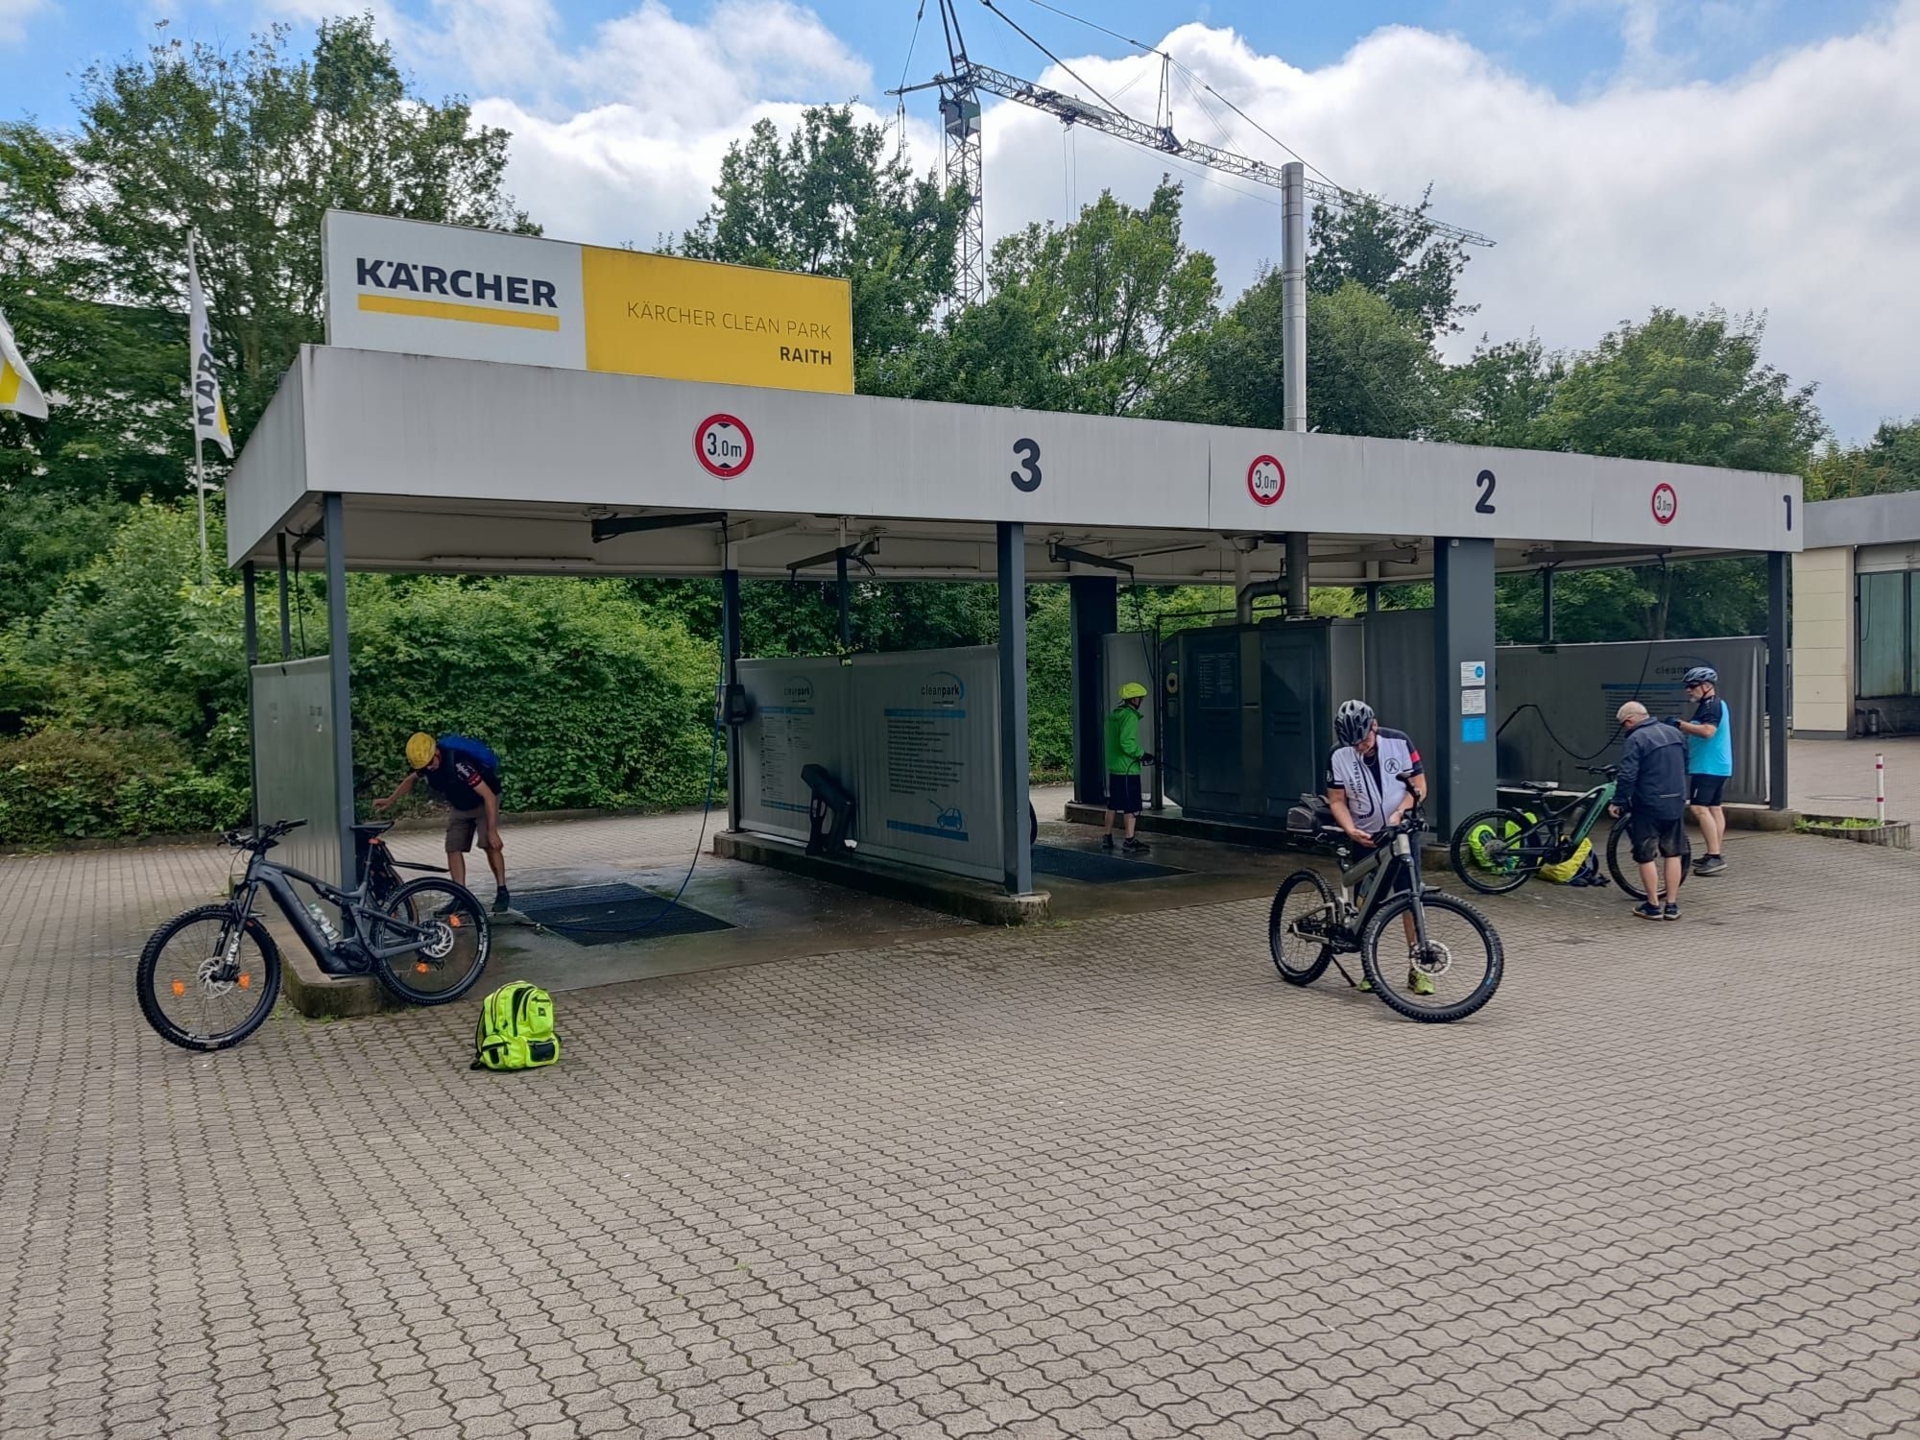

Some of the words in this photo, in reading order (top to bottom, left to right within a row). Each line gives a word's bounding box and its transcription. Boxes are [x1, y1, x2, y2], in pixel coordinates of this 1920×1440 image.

[356, 257, 558, 308] KÄRCHER
[627, 300, 716, 327] KÄRCHER
[722, 313, 780, 334] CLEAN
[786, 320, 832, 340] PARK
[196, 324, 217, 426] KÄRC
[779, 346, 832, 365] RAITH
[1011, 437, 1042, 492] 3
[1475, 469, 1496, 514] 2
[1783, 494, 1791, 531] 1
[921, 683, 960, 698] cleanpark
